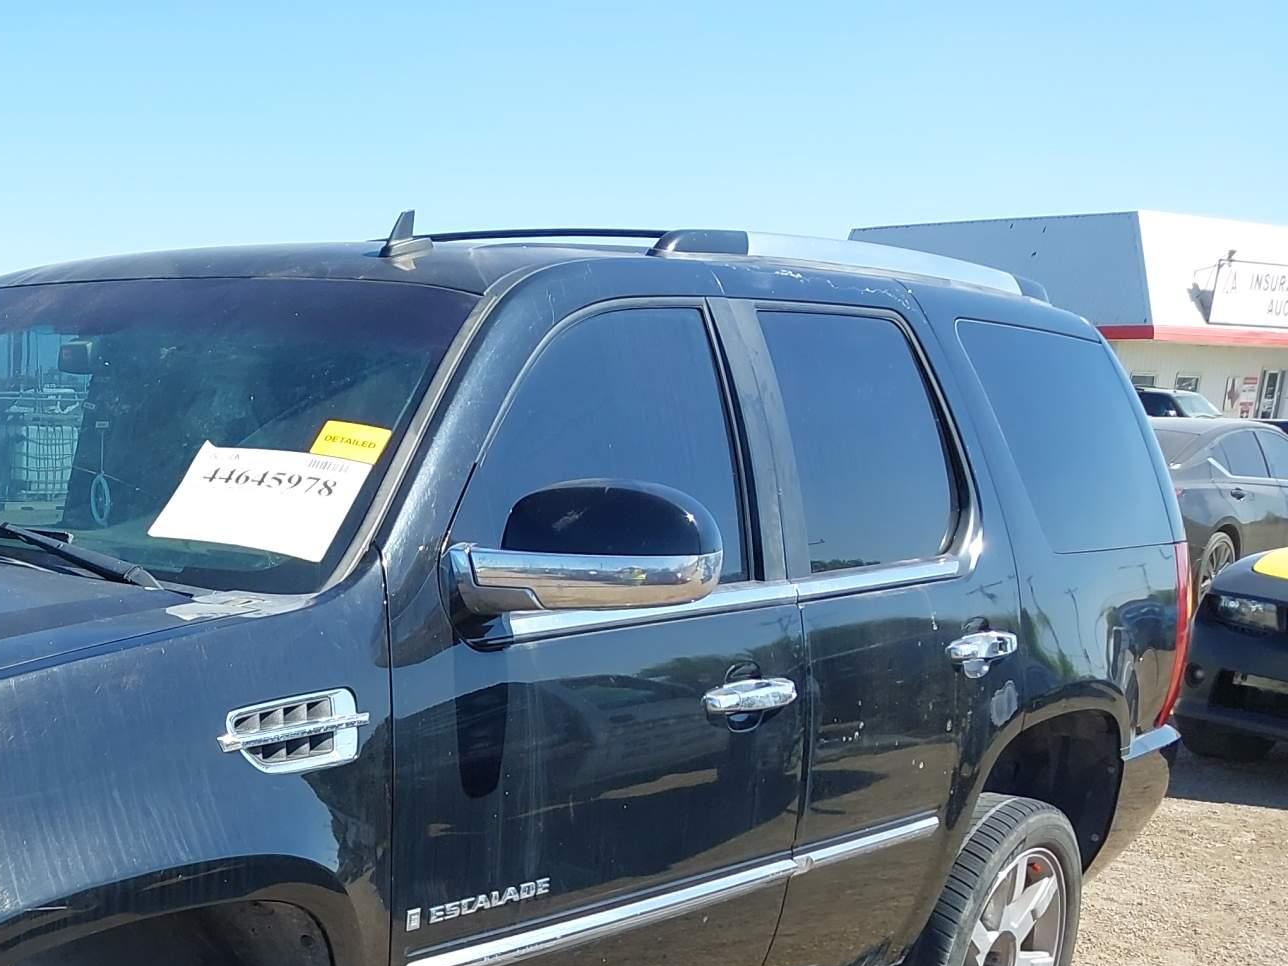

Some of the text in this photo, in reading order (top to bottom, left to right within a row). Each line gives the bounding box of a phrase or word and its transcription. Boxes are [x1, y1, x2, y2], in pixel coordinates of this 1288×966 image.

[324, 434, 377, 449] DETAILED
[203, 468, 338, 497] 44645978
[429, 877, 551, 924] ESCALADE
